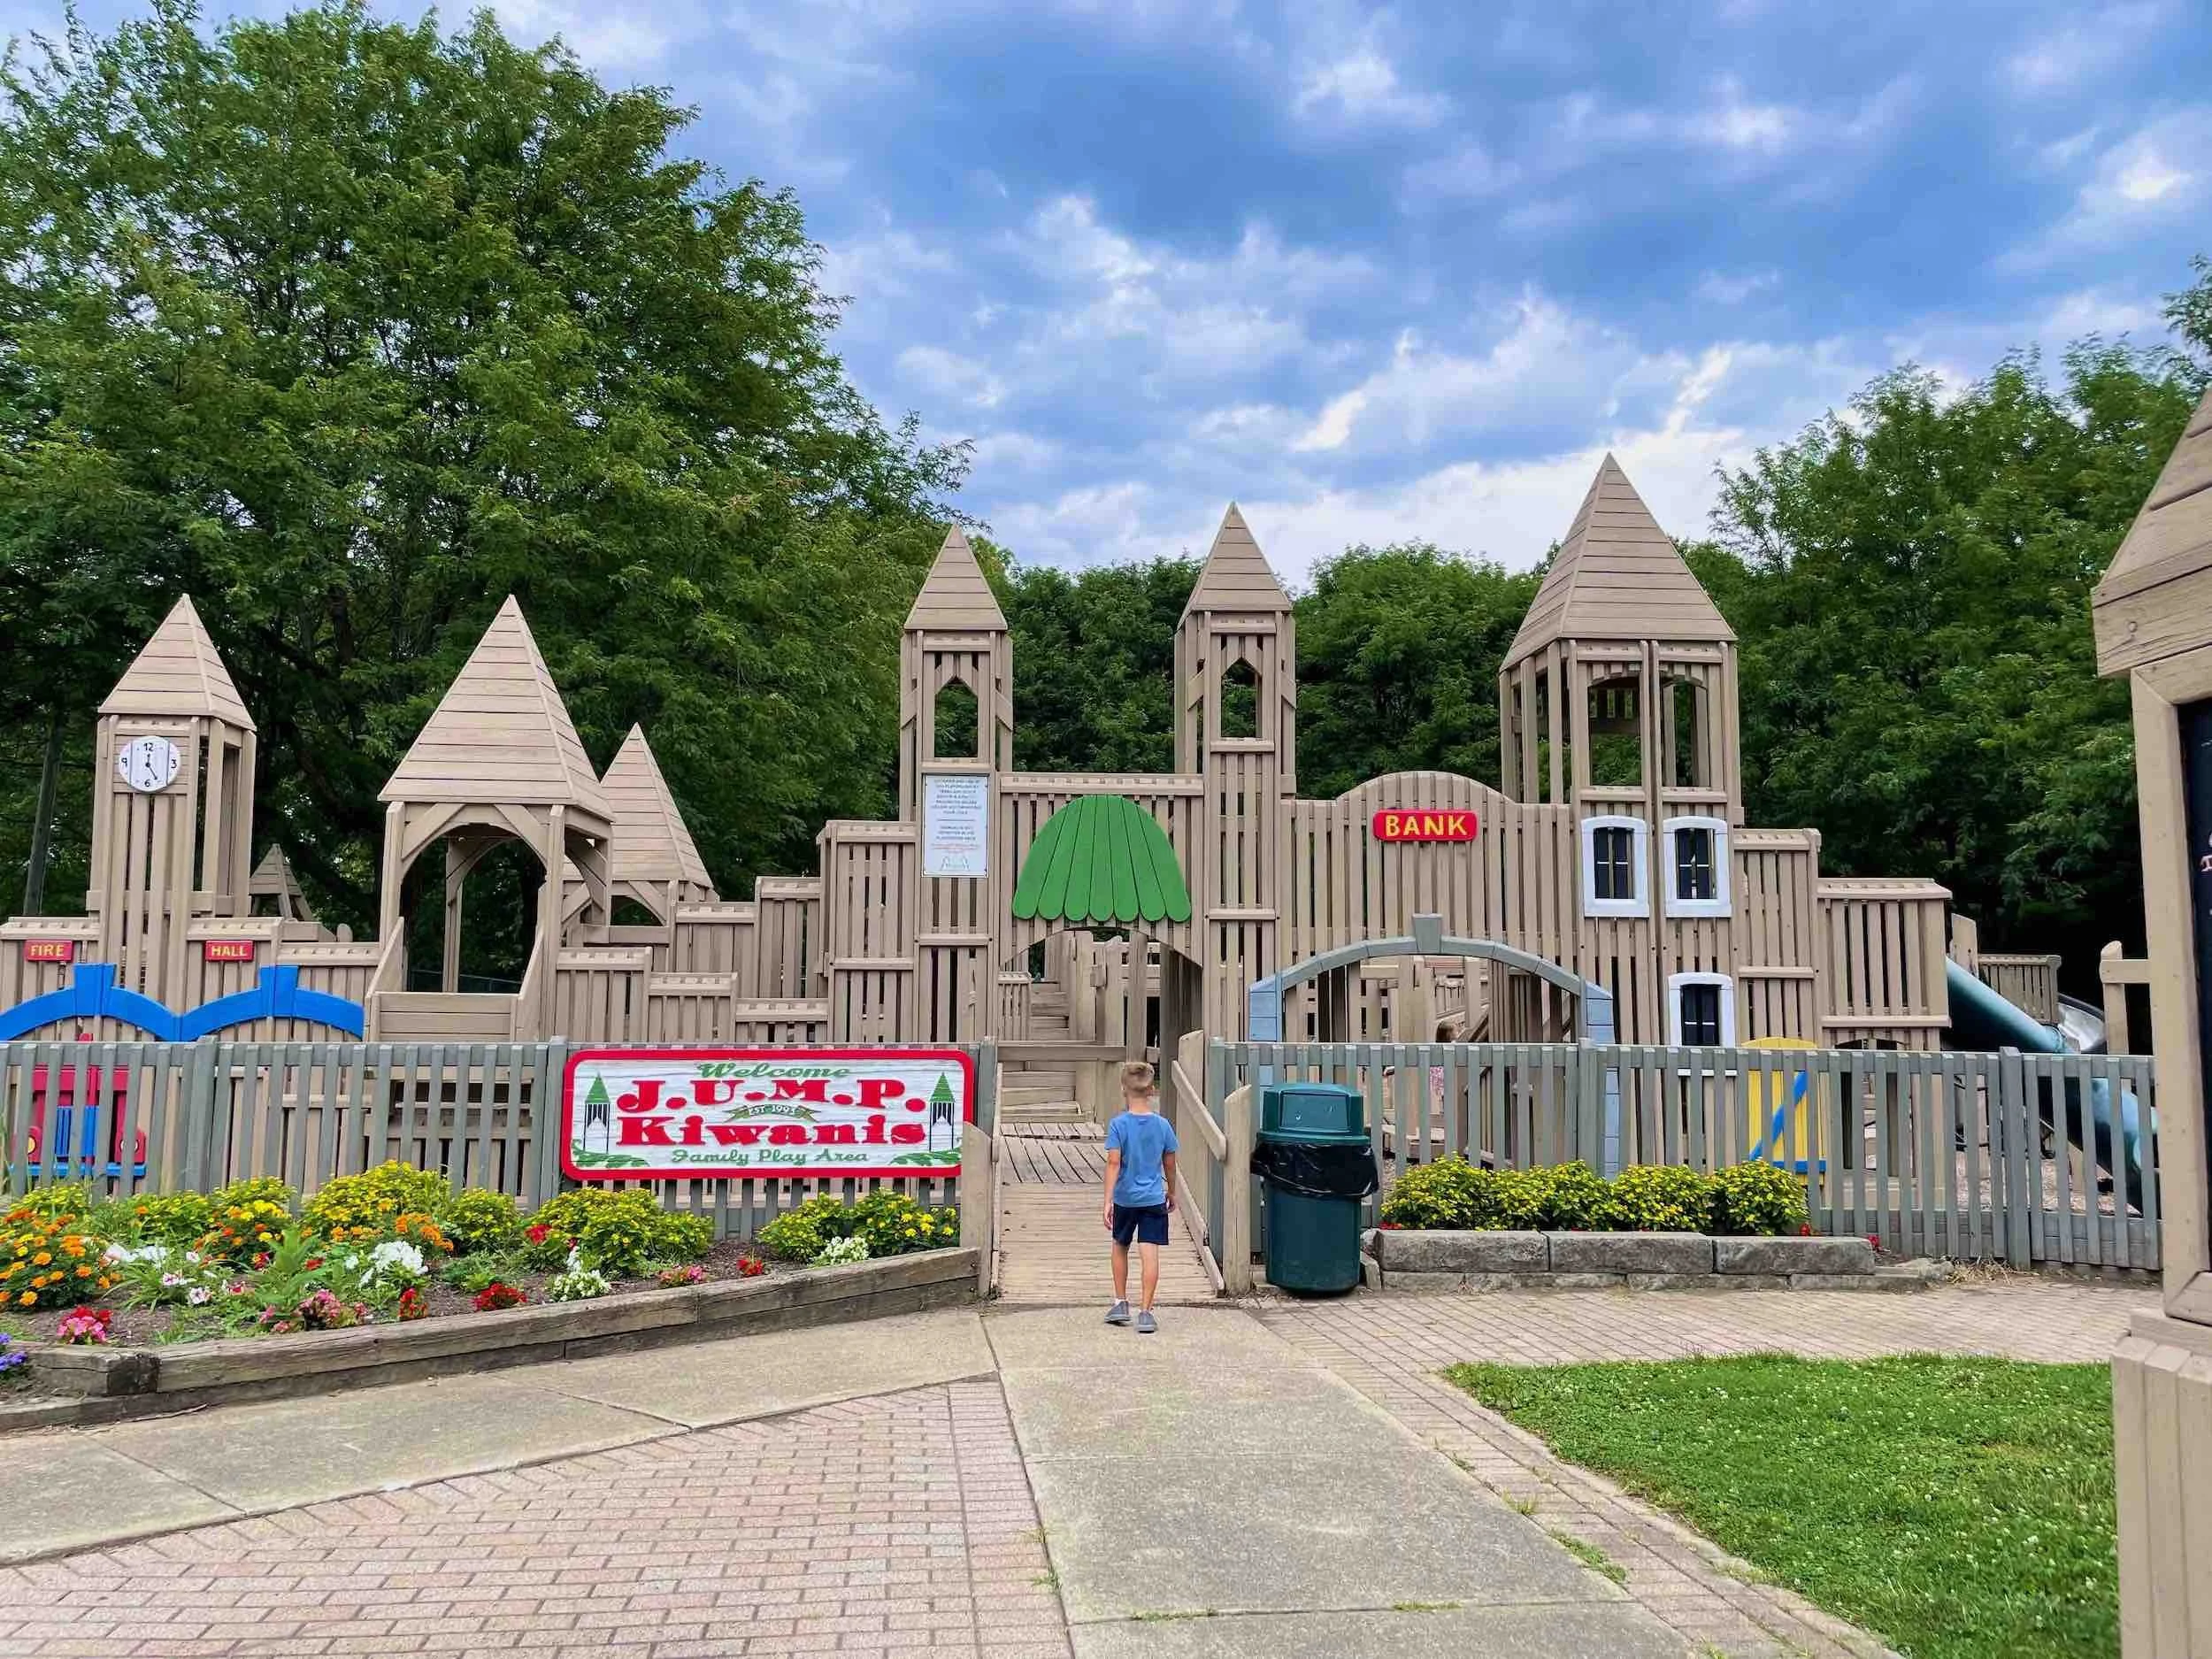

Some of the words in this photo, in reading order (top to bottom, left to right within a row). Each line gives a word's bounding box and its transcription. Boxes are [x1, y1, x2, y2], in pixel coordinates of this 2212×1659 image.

[121, 757, 127, 767] 9
[171, 758, 177, 769] 3
[1385, 815, 1468, 836] BANK
[30, 945, 65, 956] FIRE
[211, 946, 248, 957] HALL
[696, 1063, 850, 1078] Welcome
[617, 1079, 926, 1112] J.U.M.P.
[617, 1115, 926, 1146] Kiwanis
[672, 1149, 749, 1166] Family
[759, 1149, 806, 1166] Play
[814, 1148, 869, 1162] Area
